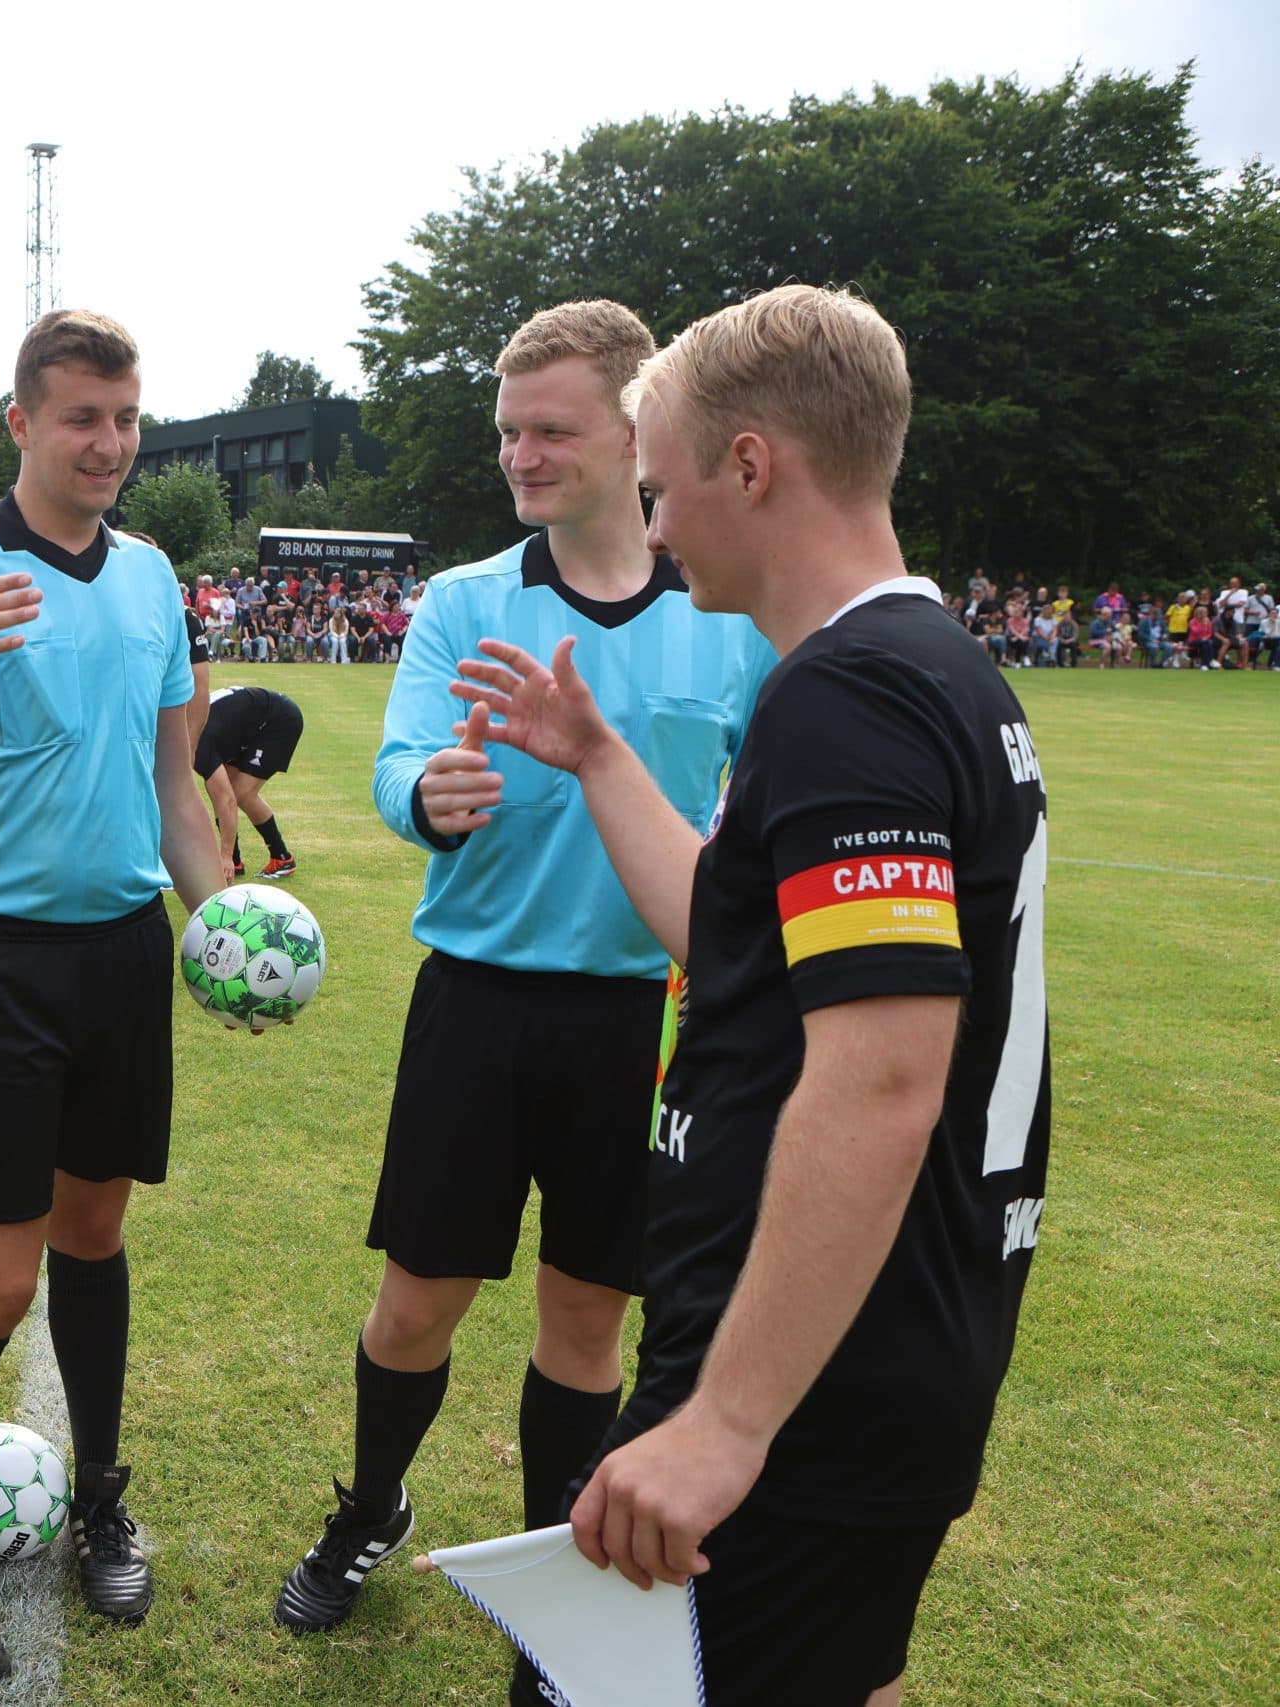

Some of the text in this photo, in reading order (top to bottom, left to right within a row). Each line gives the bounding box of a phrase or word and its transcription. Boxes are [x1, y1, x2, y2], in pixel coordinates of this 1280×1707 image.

[278, 541, 395, 559] 28 BLACK DER ENERGY DRINK
[833, 833, 865, 849] I'VE
[867, 830, 901, 844] GOT
[905, 830, 916, 843] A
[891, 905, 939, 918] IN ME!
[256, 960, 270, 982] SELECT
